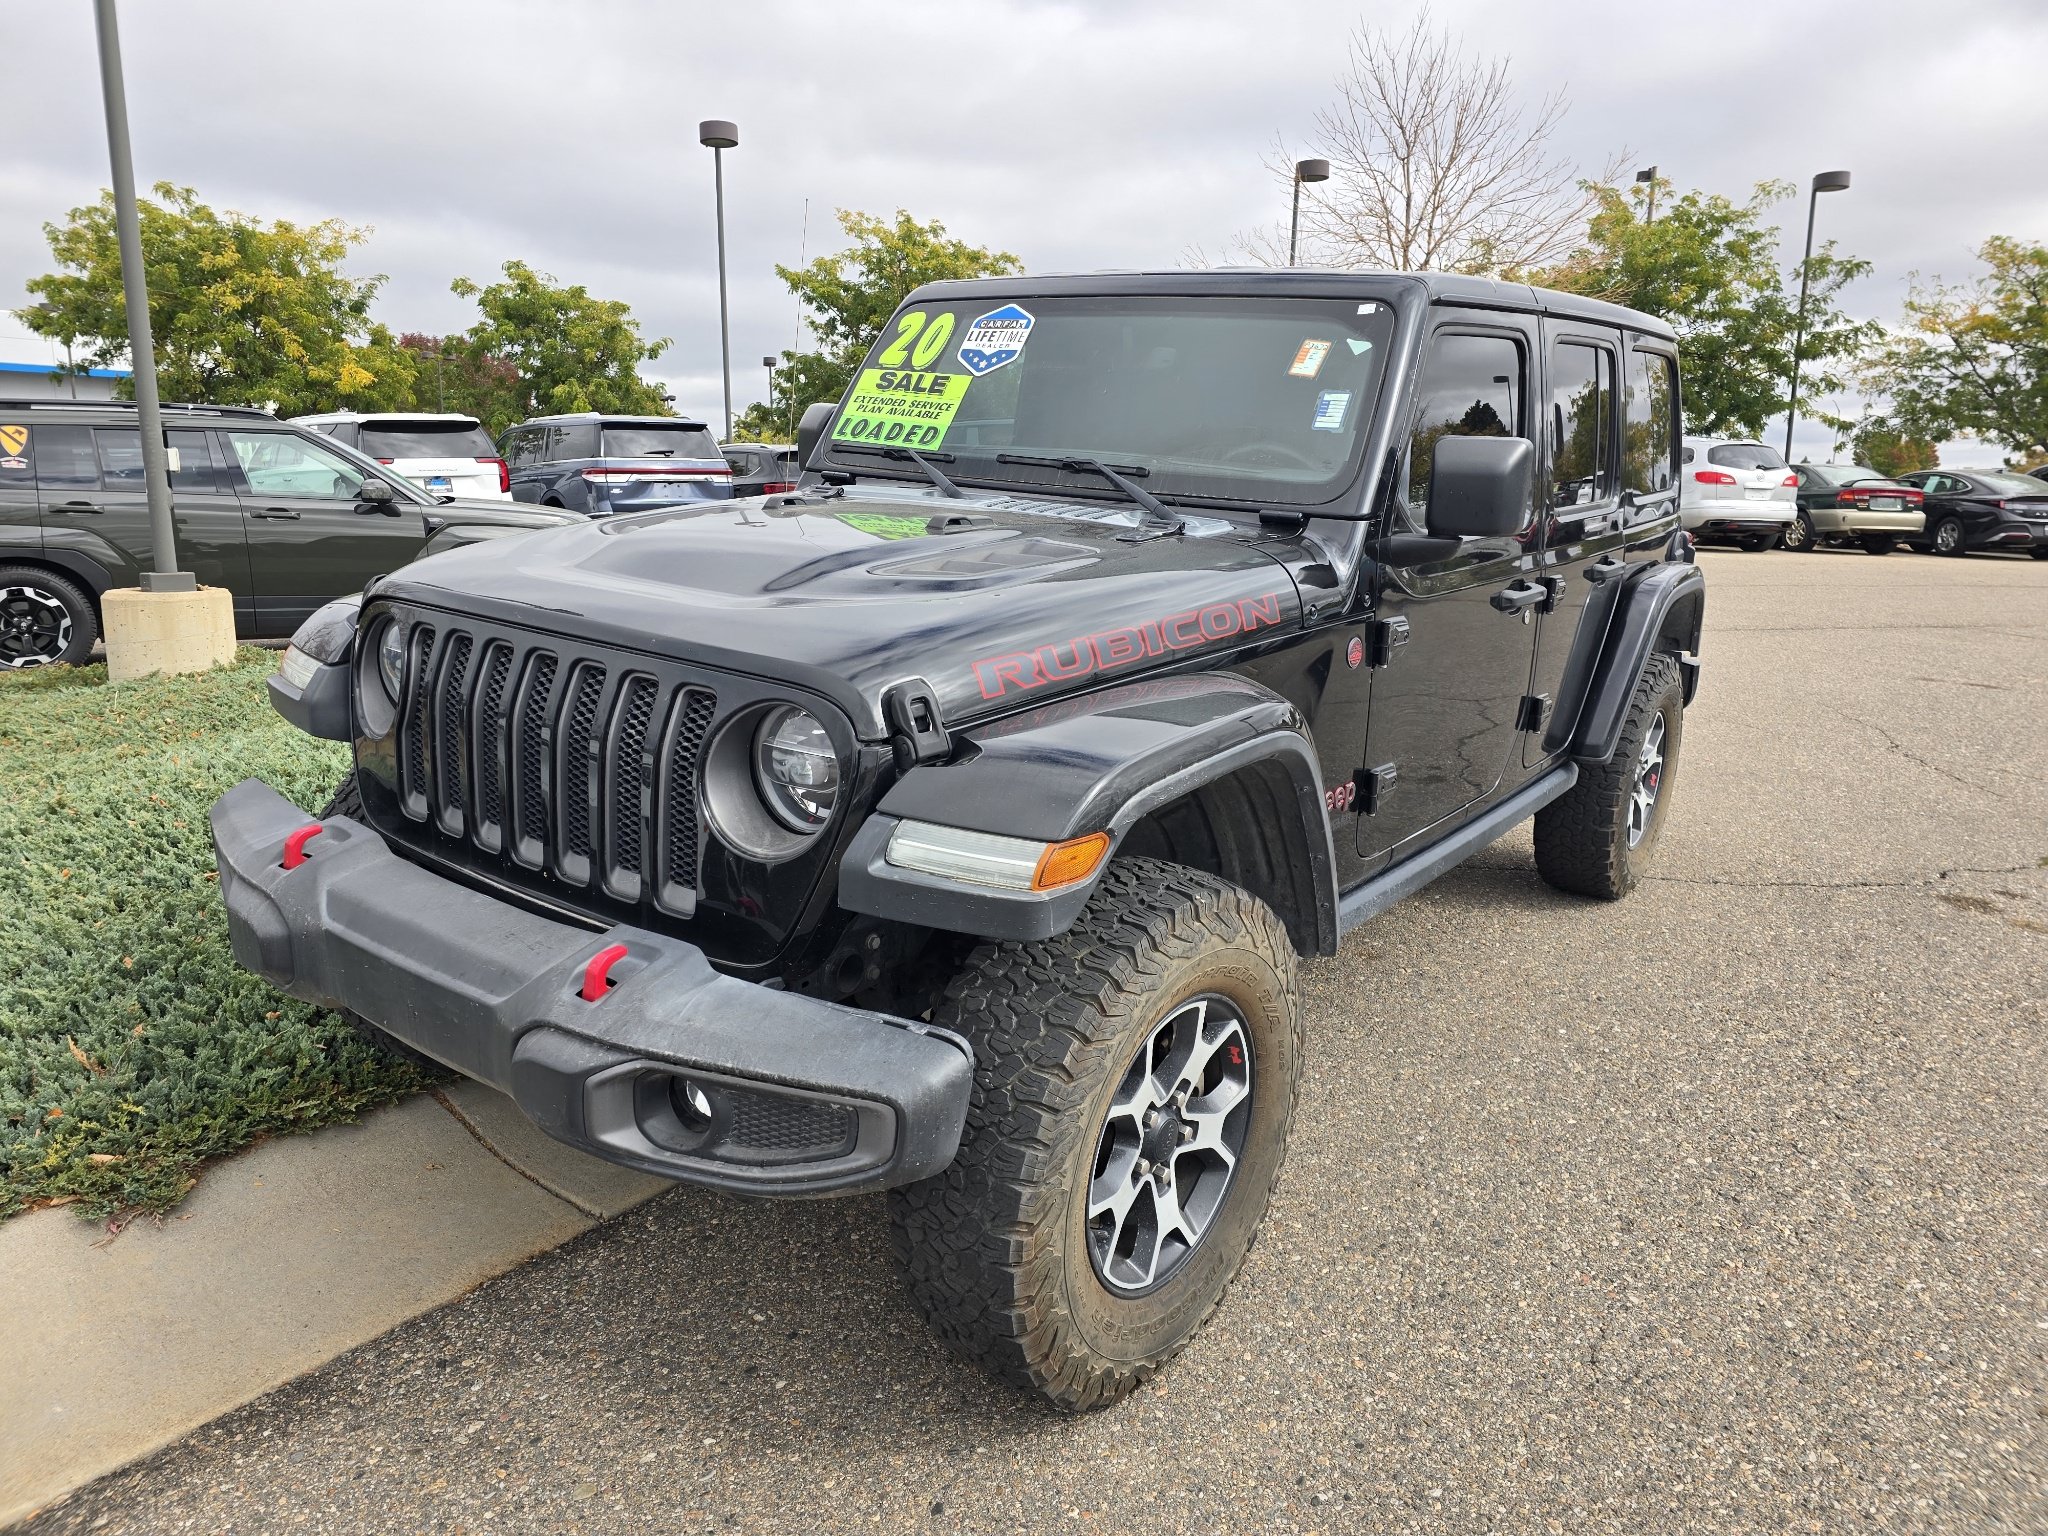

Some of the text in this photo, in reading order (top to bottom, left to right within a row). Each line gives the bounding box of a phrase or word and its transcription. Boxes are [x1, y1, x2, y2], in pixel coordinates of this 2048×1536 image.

[979, 319, 1028, 329] CARFAX
[879, 311, 955, 370] 20
[967, 330, 1027, 343] LIFETIME
[876, 371, 950, 395] SALE
[853, 395, 954, 412] EXTENDED SERVICE
[856, 404, 943, 420] PLAN AVAILABLE
[836, 418, 940, 445] LOADED
[972, 593, 1281, 699] RUBICON
[1325, 781, 1356, 812] eep
